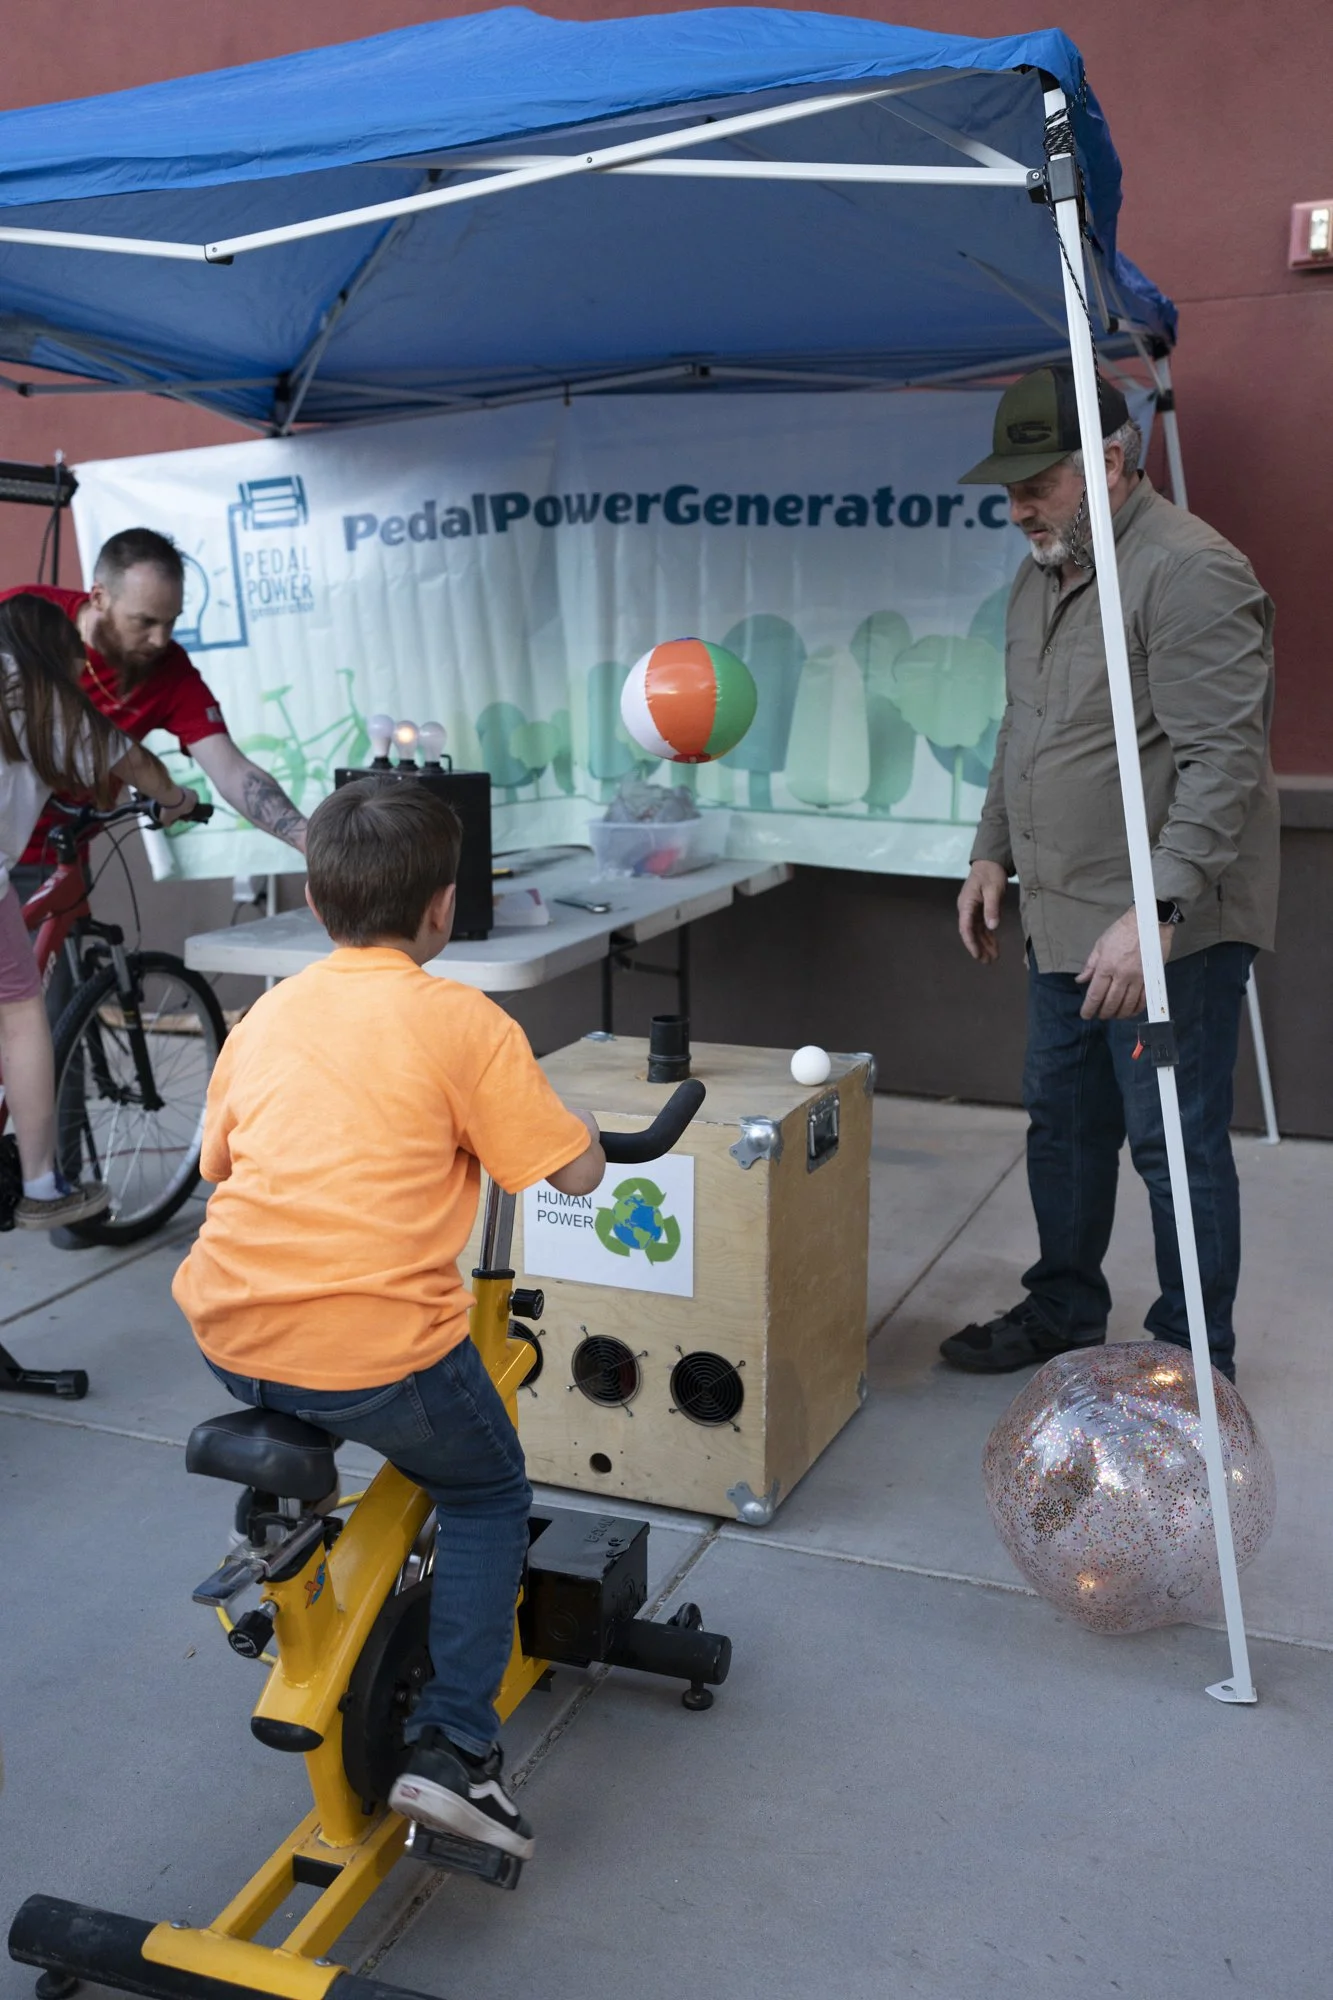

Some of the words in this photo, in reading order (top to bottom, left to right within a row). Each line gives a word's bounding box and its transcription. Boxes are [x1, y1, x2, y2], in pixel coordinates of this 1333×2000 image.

[343, 484, 1009, 551] PedalPowerGenerator.c
[244, 546, 311, 577] PEDAL
[246, 574, 313, 604] POWER
[537, 1190, 592, 1209] HUMAN
[537, 1209, 594, 1229] POWER
